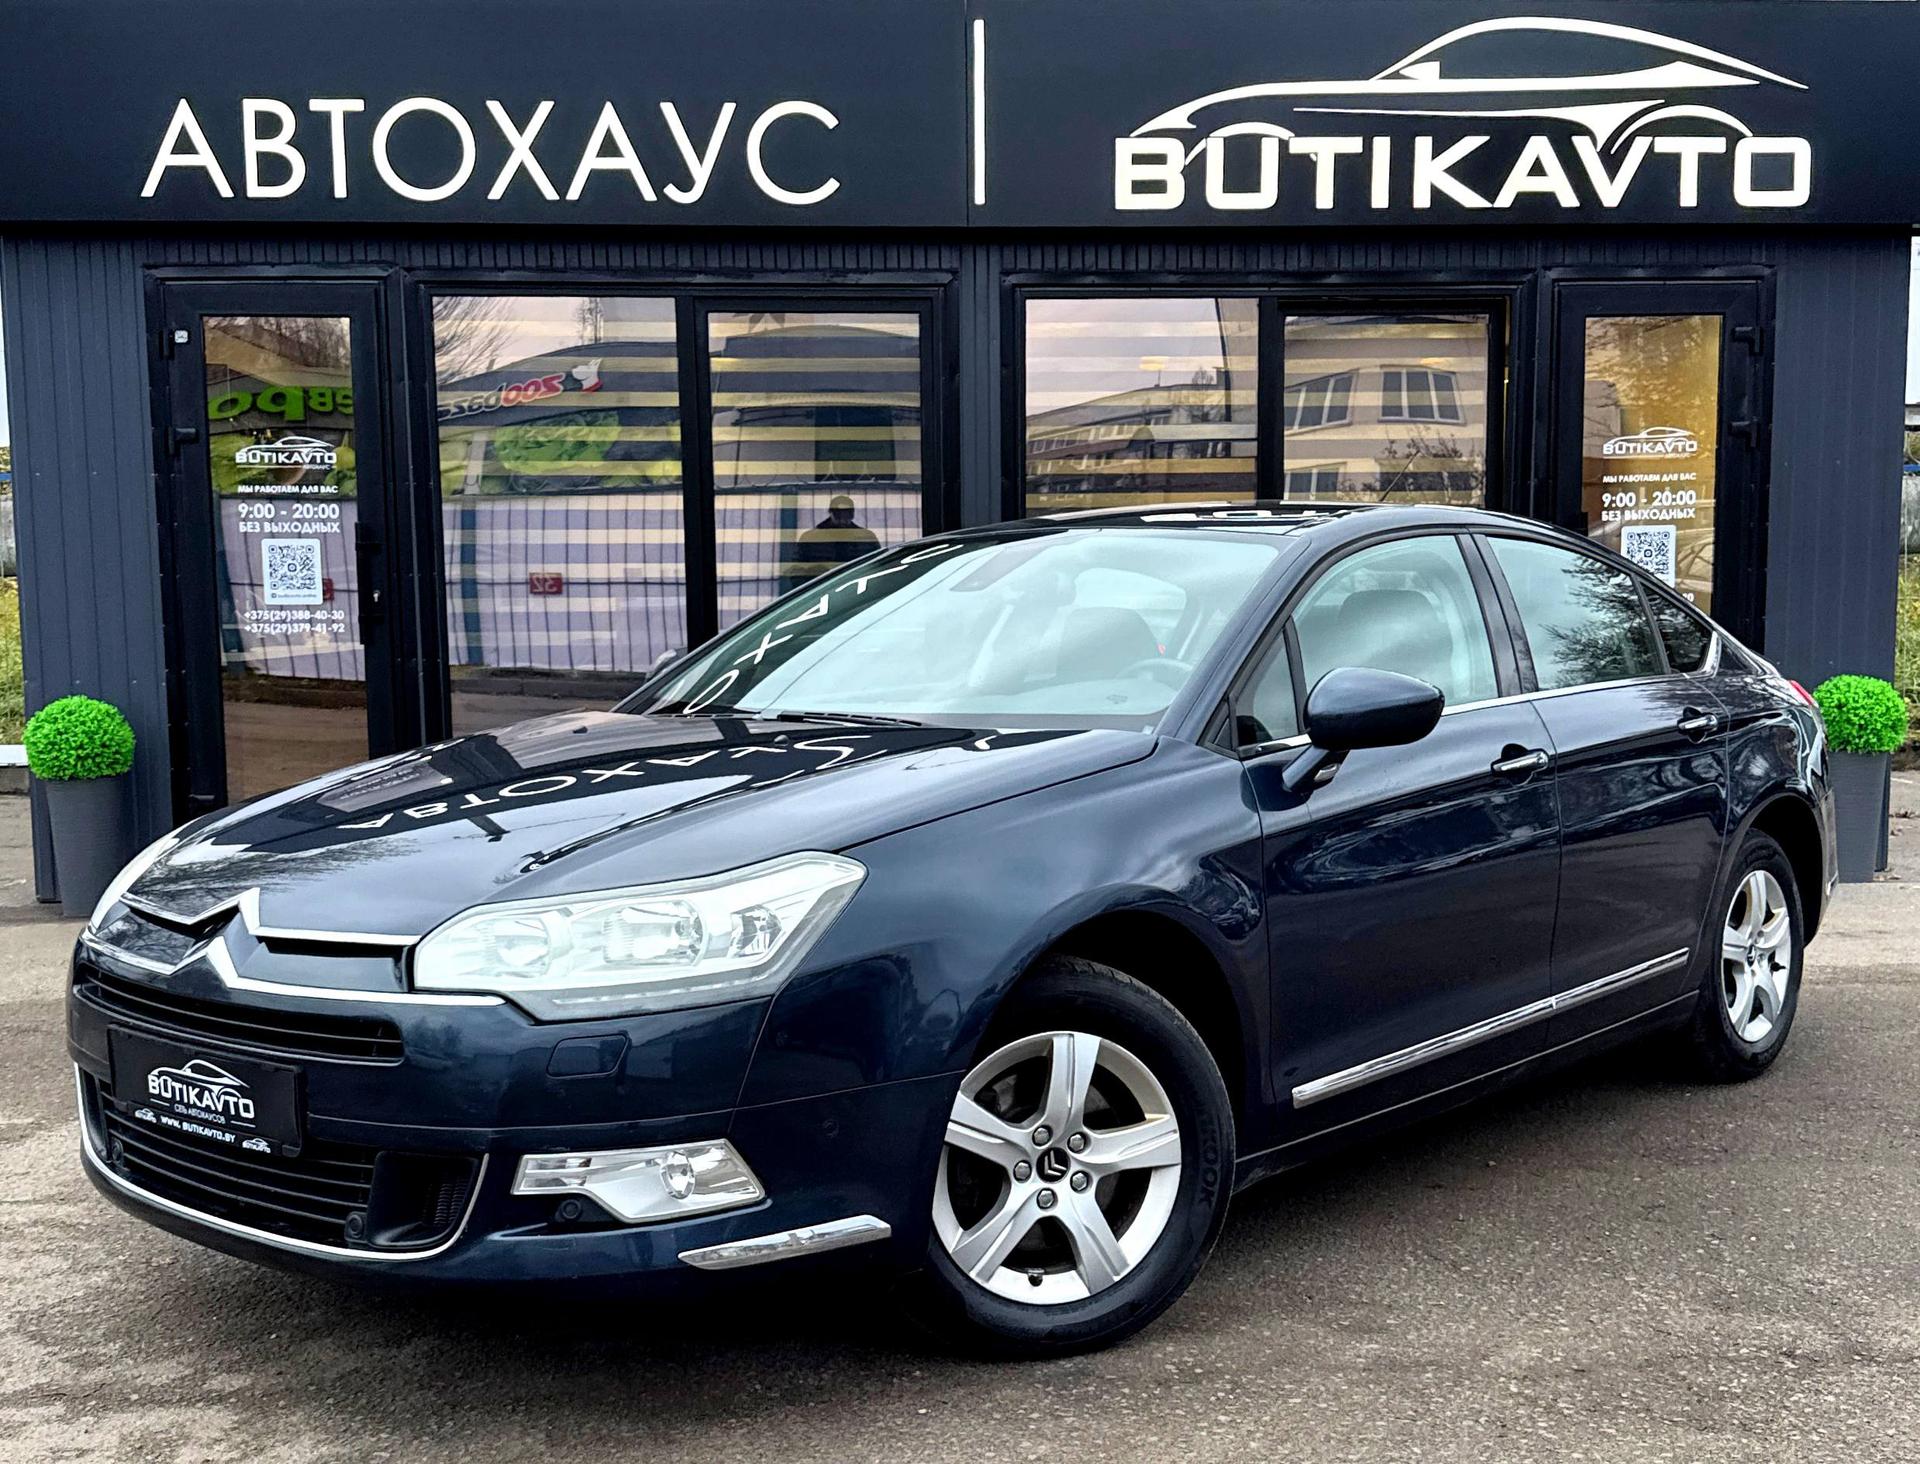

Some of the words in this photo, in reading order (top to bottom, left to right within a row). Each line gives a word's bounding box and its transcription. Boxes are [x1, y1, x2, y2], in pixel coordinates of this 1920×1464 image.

[141, 97, 840, 205] АВТОХАУС
[1114, 135, 1812, 211] BUTIKAVTO
[1602, 441, 1698, 455] BUTIKAVTO
[235, 450, 338, 464] BUTIKAVTO
[1603, 475, 1617, 483] МЫ
[1618, 473, 1660, 483] РАБОТАЕМ
[1679, 472, 1697, 481] ВАС
[237, 485, 253, 494] МЫ
[255, 485, 300, 494] РАБОТАЕМ
[301, 485, 319, 494] ДЛЯ
[320, 485, 339, 494] ВАС
[1602, 492, 1636, 508] 9:00
[1652, 490, 1696, 507] 20:00
[238, 503, 275, 519] 9:00
[292, 503, 340, 519] 20:00
[1601, 510, 1621, 522] БЕЗ
[1625, 508, 1696, 521] ВЫХОДНЫХ
[239, 522, 261, 533] БЕЗ
[263, 521, 341, 534] ВЫХОДНЫХ
[148, 1074, 255, 1119] BUTIKAVTO
